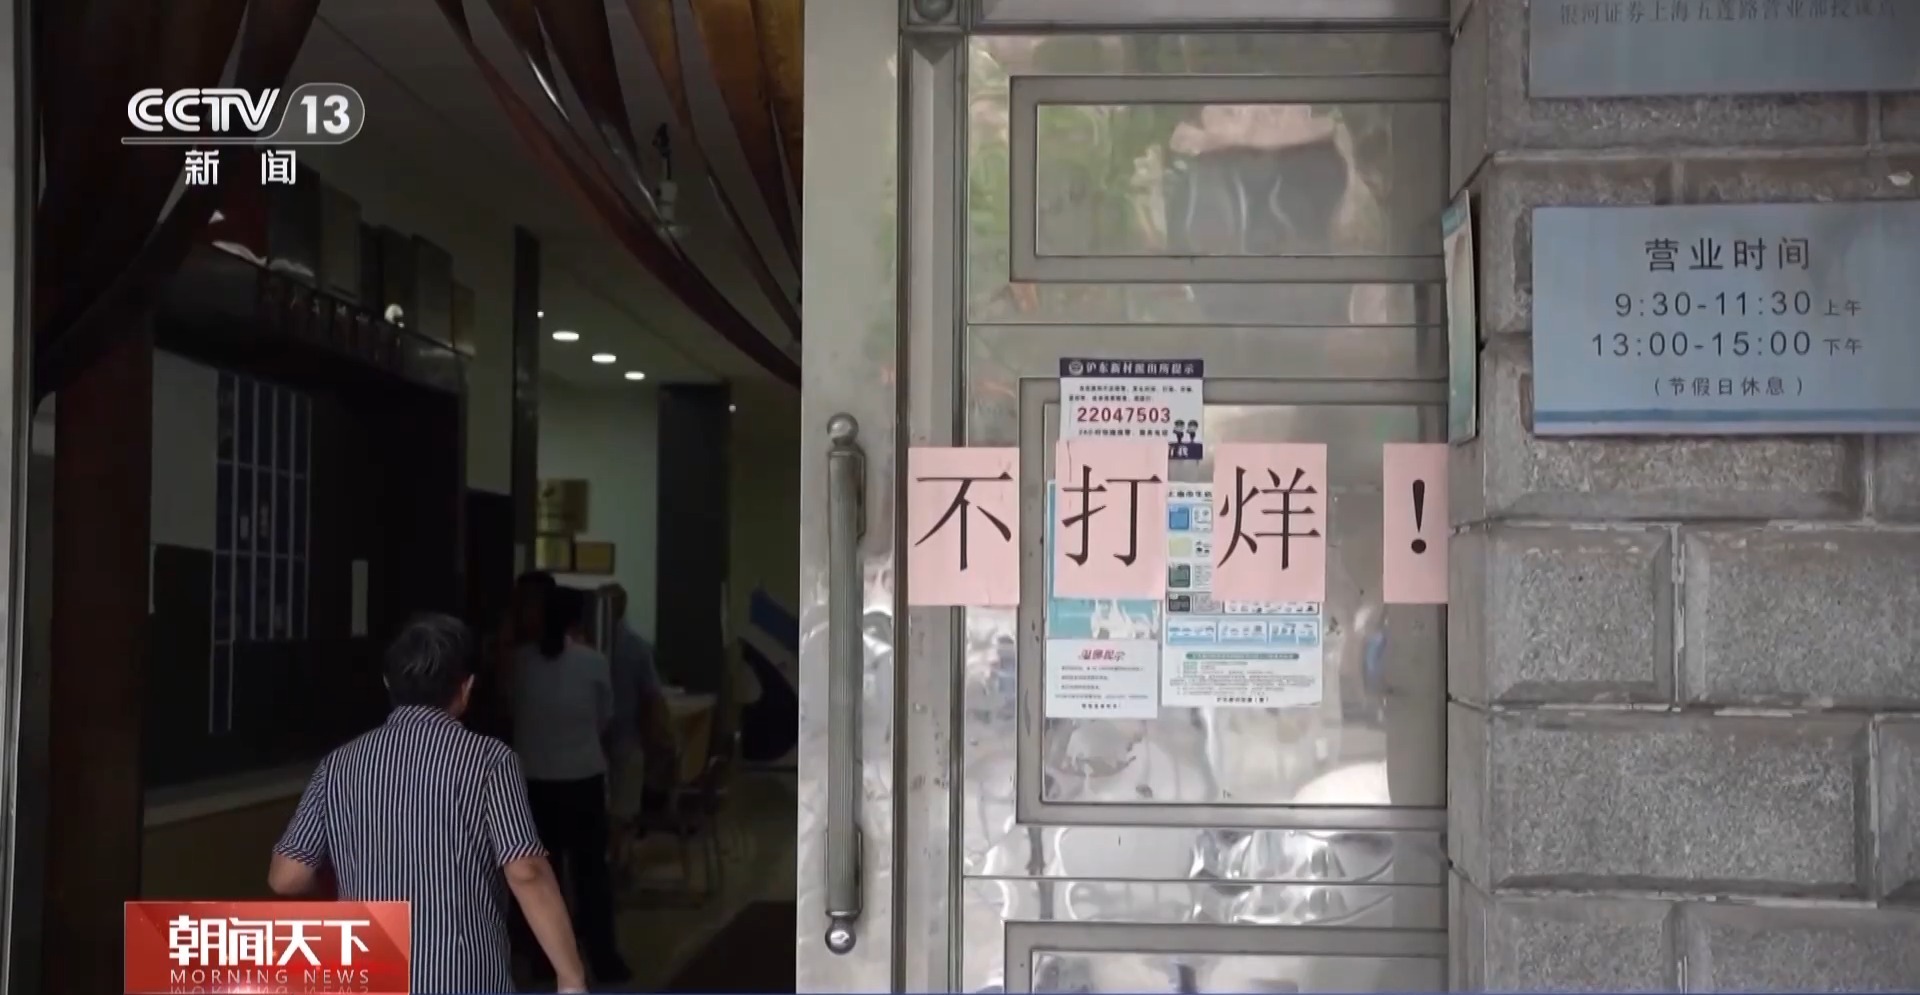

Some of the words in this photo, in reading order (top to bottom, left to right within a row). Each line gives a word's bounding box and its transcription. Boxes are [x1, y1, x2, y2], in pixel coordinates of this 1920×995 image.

[1644, 237, 1811, 272] 营业时间
[1614, 290, 1812, 318] 9:30-11:30
[1823, 298, 1864, 317] 上午
[1591, 331, 1812, 358] 13:00-15:00
[1823, 338, 1864, 357] 下午
[1077, 407, 1171, 423] 22047503
